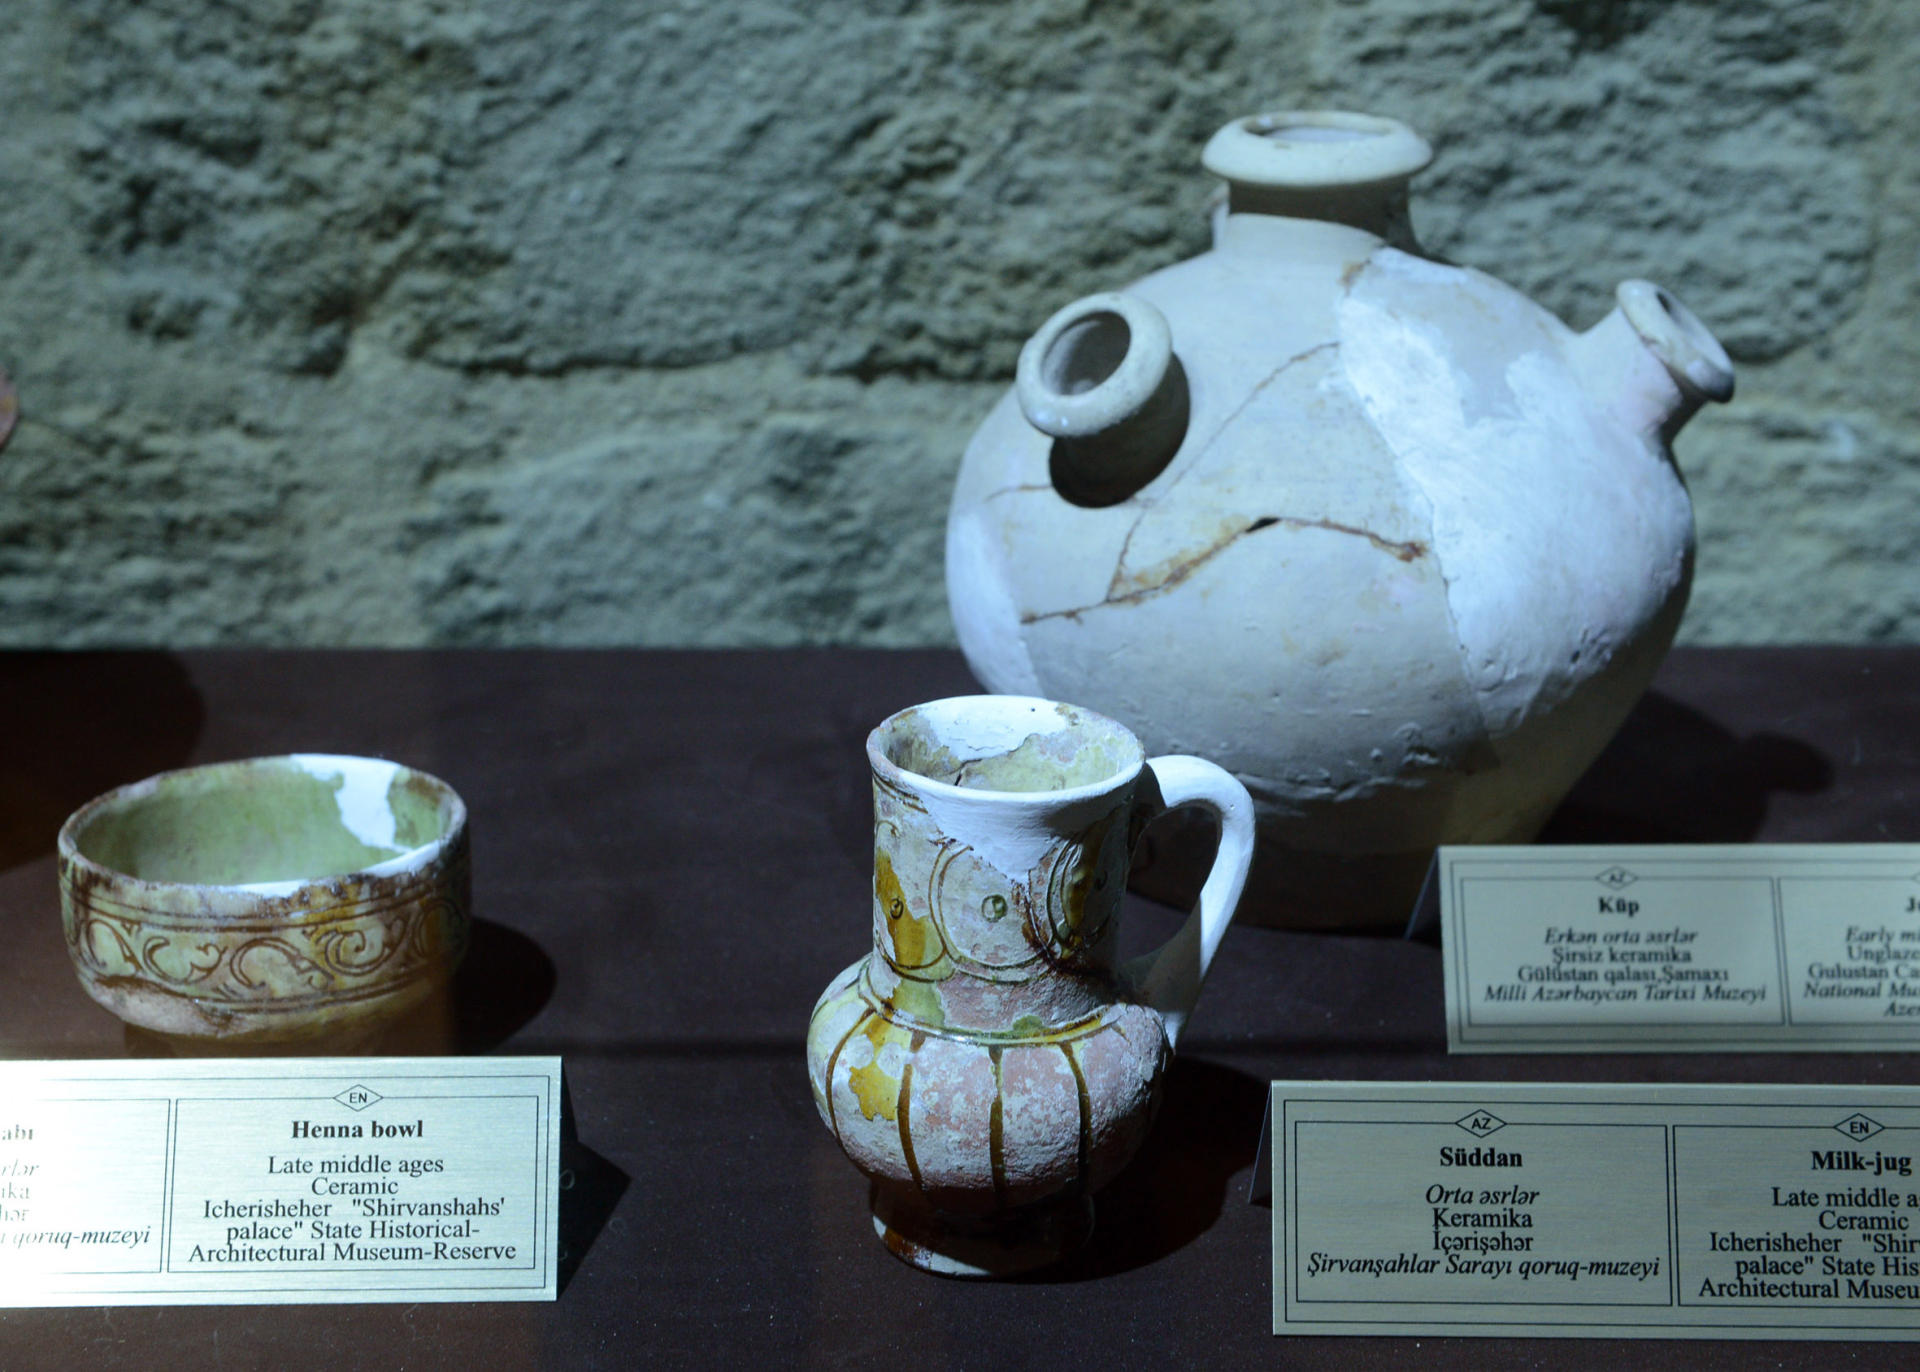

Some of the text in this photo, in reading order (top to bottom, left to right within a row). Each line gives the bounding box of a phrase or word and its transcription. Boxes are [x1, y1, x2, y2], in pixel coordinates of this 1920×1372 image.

[1599, 895, 1640, 918] Küp
[1602, 931, 1640, 944] orta
[1846, 926, 1894, 946] Early
[1552, 946, 1692, 968] Şirsiz keramika
[1517, 964, 1598, 982] Gülüstan
[1808, 962, 1889, 979] Gulustan
[1484, 984, 1767, 1006] Milli Azərbaycan Tarixi Muzeyi
[1803, 980, 1882, 998] National
[349, 1092, 368, 1104] EN
[292, 1120, 424, 1138] Henna bowl
[1471, 1118, 1492, 1130] AZ
[1850, 1122, 1869, 1134] EN
[268, 1154, 444, 1178] Late middle ages
[1440, 1147, 1523, 1168] Süddan
[1811, 1151, 1913, 1176] Milk-jug
[311, 1177, 399, 1195] Ceramic
[1425, 1184, 1540, 1206] Orta əsrlər
[203, 1197, 505, 1218] Icherisheher "Shirvanshahs'
[1771, 1187, 1820, 1207] Late
[1826, 1187, 1901, 1208] middle
[1432, 1207, 1533, 1228] Keramika
[1818, 1210, 1909, 1231] Ceramic
[13, 1225, 151, 1249] qoruq-muzeyi
[227, 1219, 481, 1245] palace" State Historical-
[1432, 1229, 1534, 1254] İçərişəhər
[188, 1241, 517, 1263] Architectural Museum-Reserve
[1709, 1232, 1920, 1254] Icherisheher "Shir
[1307, 1252, 1660, 1281] Şirvanşahlar Sarayı qoruq-muzeyi
[1735, 1255, 1920, 1281] palace" State His
[1699, 1277, 1840, 1299] Architectural
